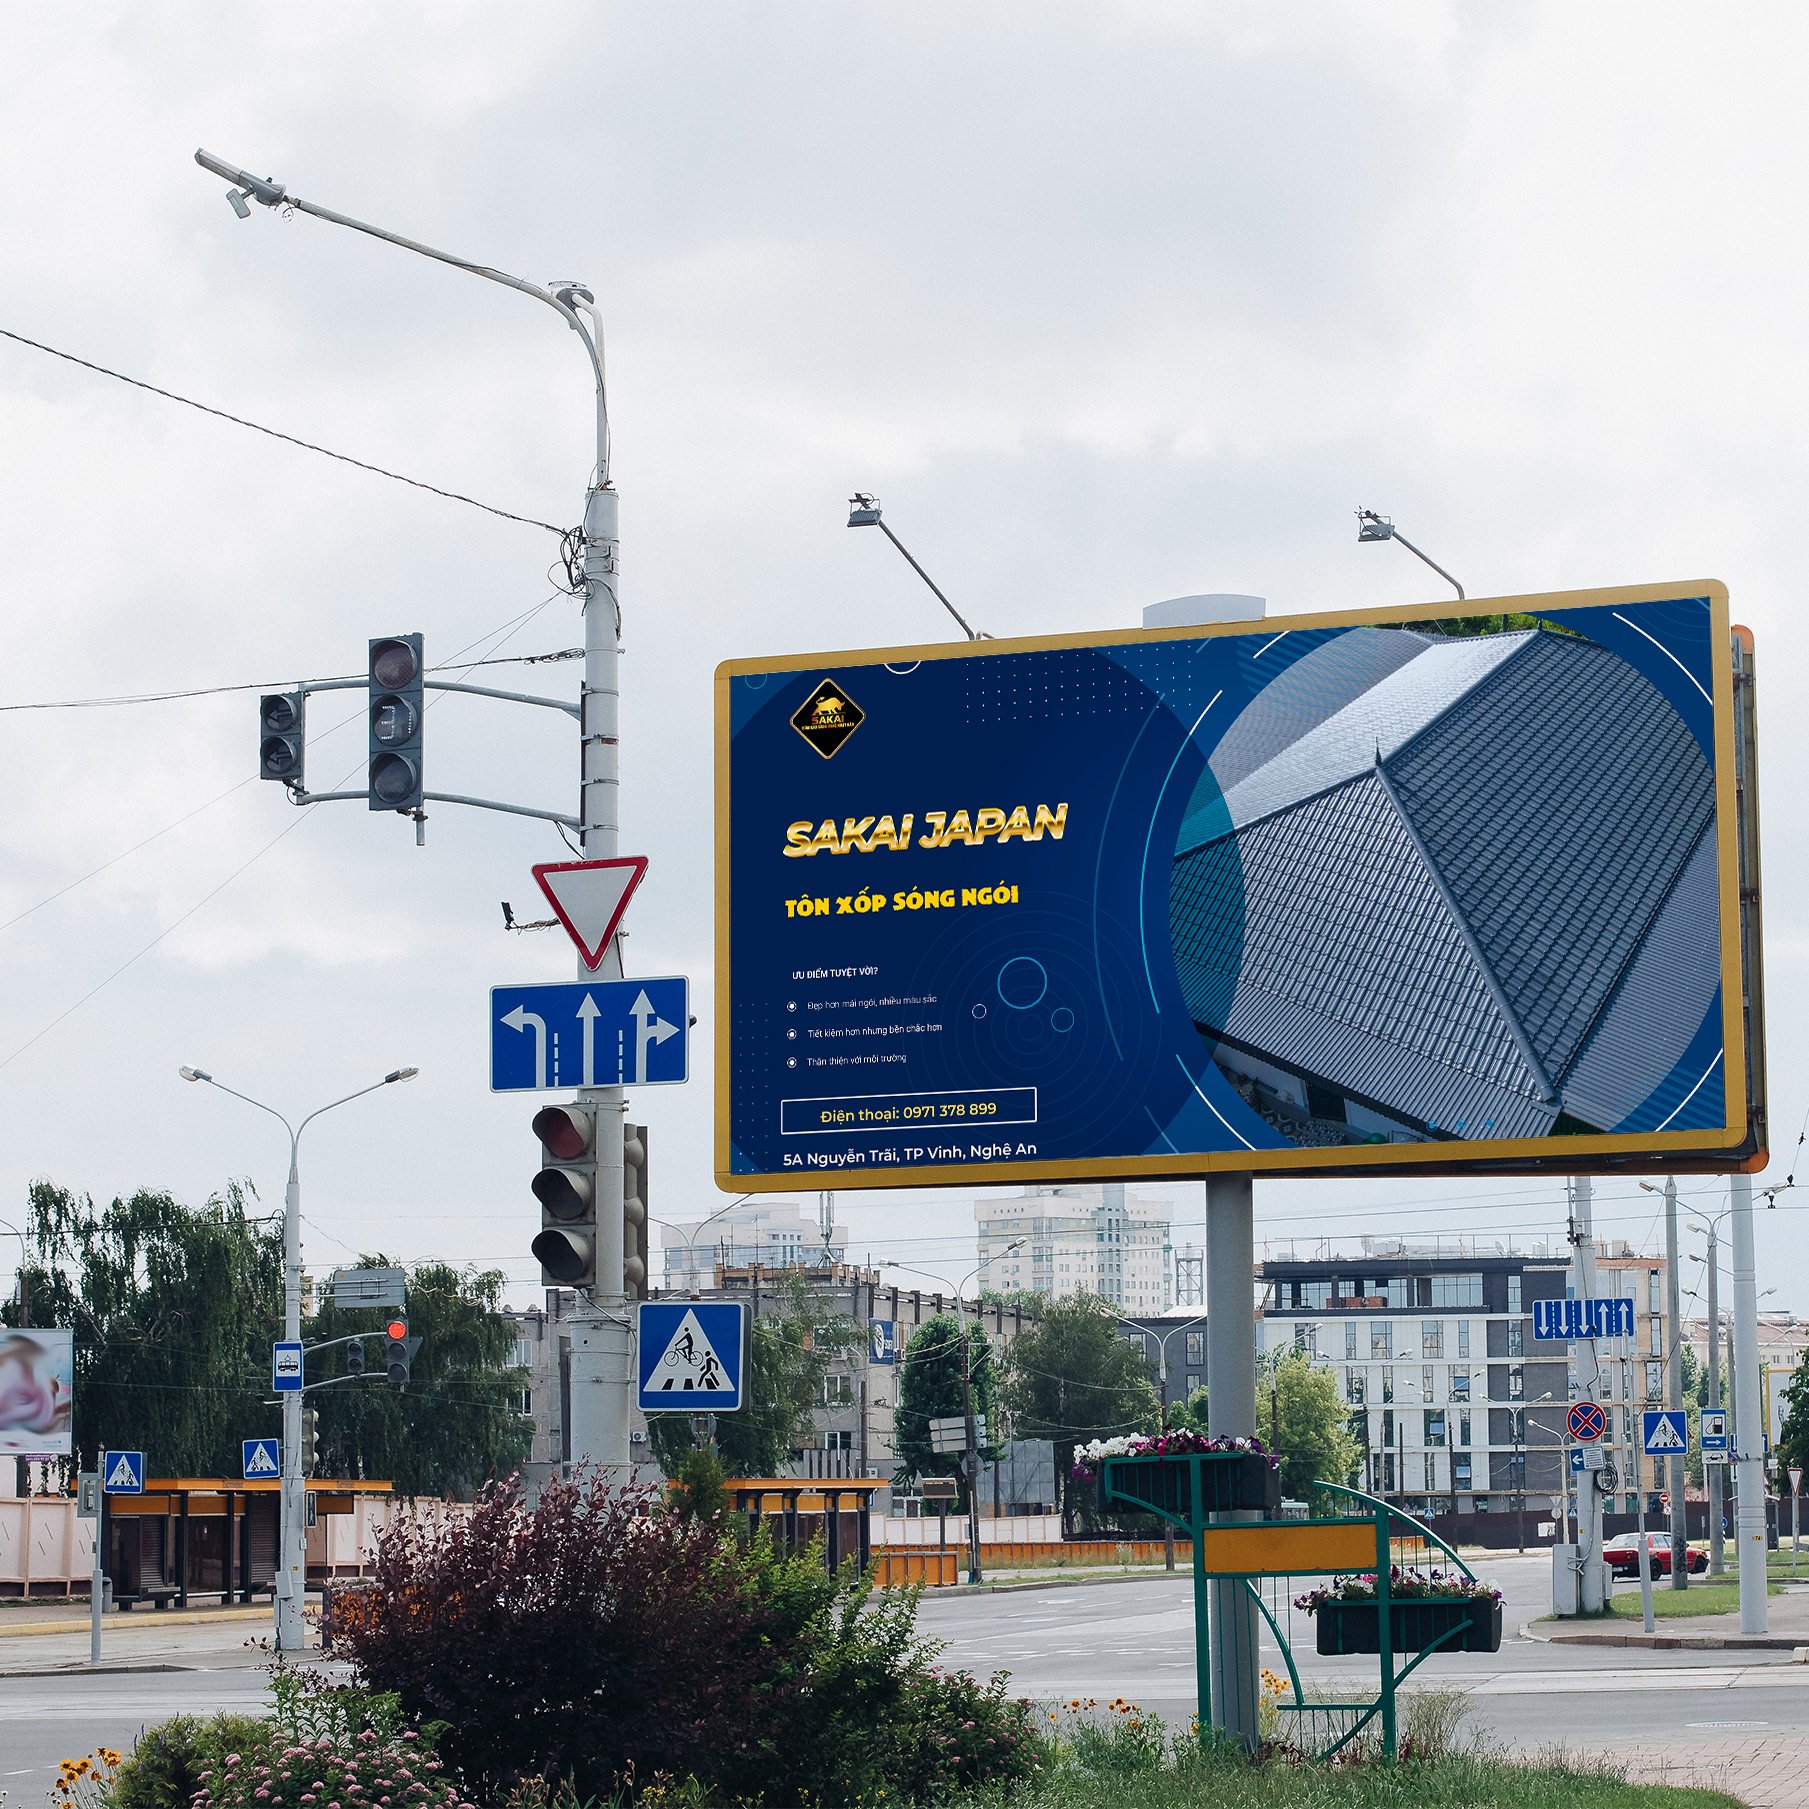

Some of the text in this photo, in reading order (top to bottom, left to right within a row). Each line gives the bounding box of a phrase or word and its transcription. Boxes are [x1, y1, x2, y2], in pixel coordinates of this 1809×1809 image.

[811, 714, 845, 725] SAKAI
[782, 803, 1069, 858] SAKAI JAPAN
[785, 880, 1018, 918] TÔN XỐP SÓNG NGÓI
[807, 967, 828, 979] ĐIỂM
[830, 966, 857, 978] TUYỆT
[807, 1001, 824, 1011] Đẹp
[842, 999, 857, 1008] mái
[879, 996, 902, 1006] nhiều
[807, 1028, 823, 1038] Tiết
[862, 1026, 887, 1036] nhưng
[820, 1102, 997, 1125] Điện thoại: 0971 378 899
[783, 1142, 1037, 1168] 5A Nguyễn Trãi, TP Vinh, Nghệ An
